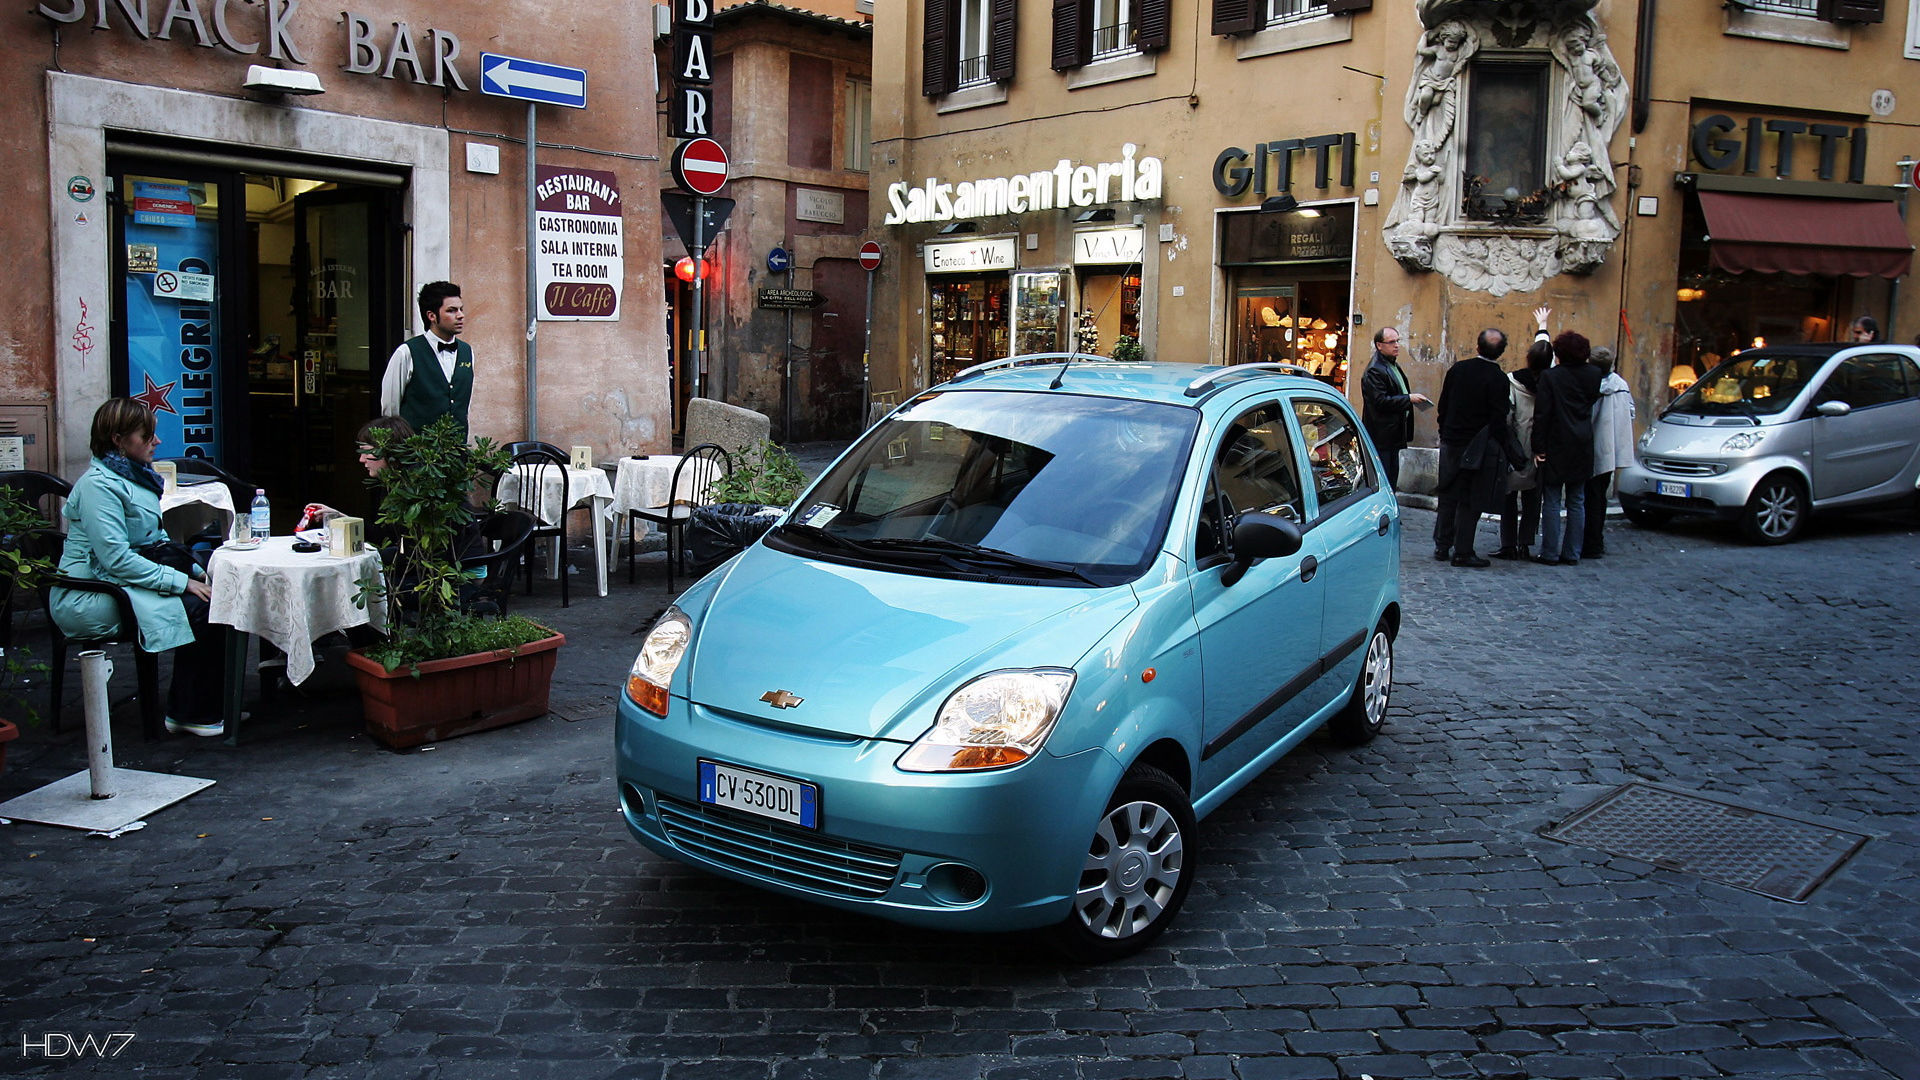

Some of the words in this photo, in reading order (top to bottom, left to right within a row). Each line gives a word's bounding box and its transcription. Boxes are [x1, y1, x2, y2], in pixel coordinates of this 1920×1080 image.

[342, 11, 469, 91] BAR
[1692, 114, 1866, 184] GITTI
[1213, 132, 1356, 197] GITTI
[536, 174, 618, 206] RESTAURANT
[884, 142, 1163, 225] Salsamenteria
[566, 193, 590, 211] BAR
[140, 214, 165, 224] CHIUSO
[539, 216, 618, 236] GASTRONOMIA
[541, 239, 568, 255] SALA
[572, 241, 618, 257] INTERNA
[1290, 233, 1323, 244] REGALI
[933, 249, 966, 267] Enoteca
[981, 246, 1004, 264] Wine
[552, 262, 572, 277] TEA
[576, 264, 608, 278] ROOM
[316, 280, 353, 298] BAR
[550, 286, 567, 309] Il
[571, 286, 612, 313] Caffè
[178, 257, 215, 463] PELLEGRIO
